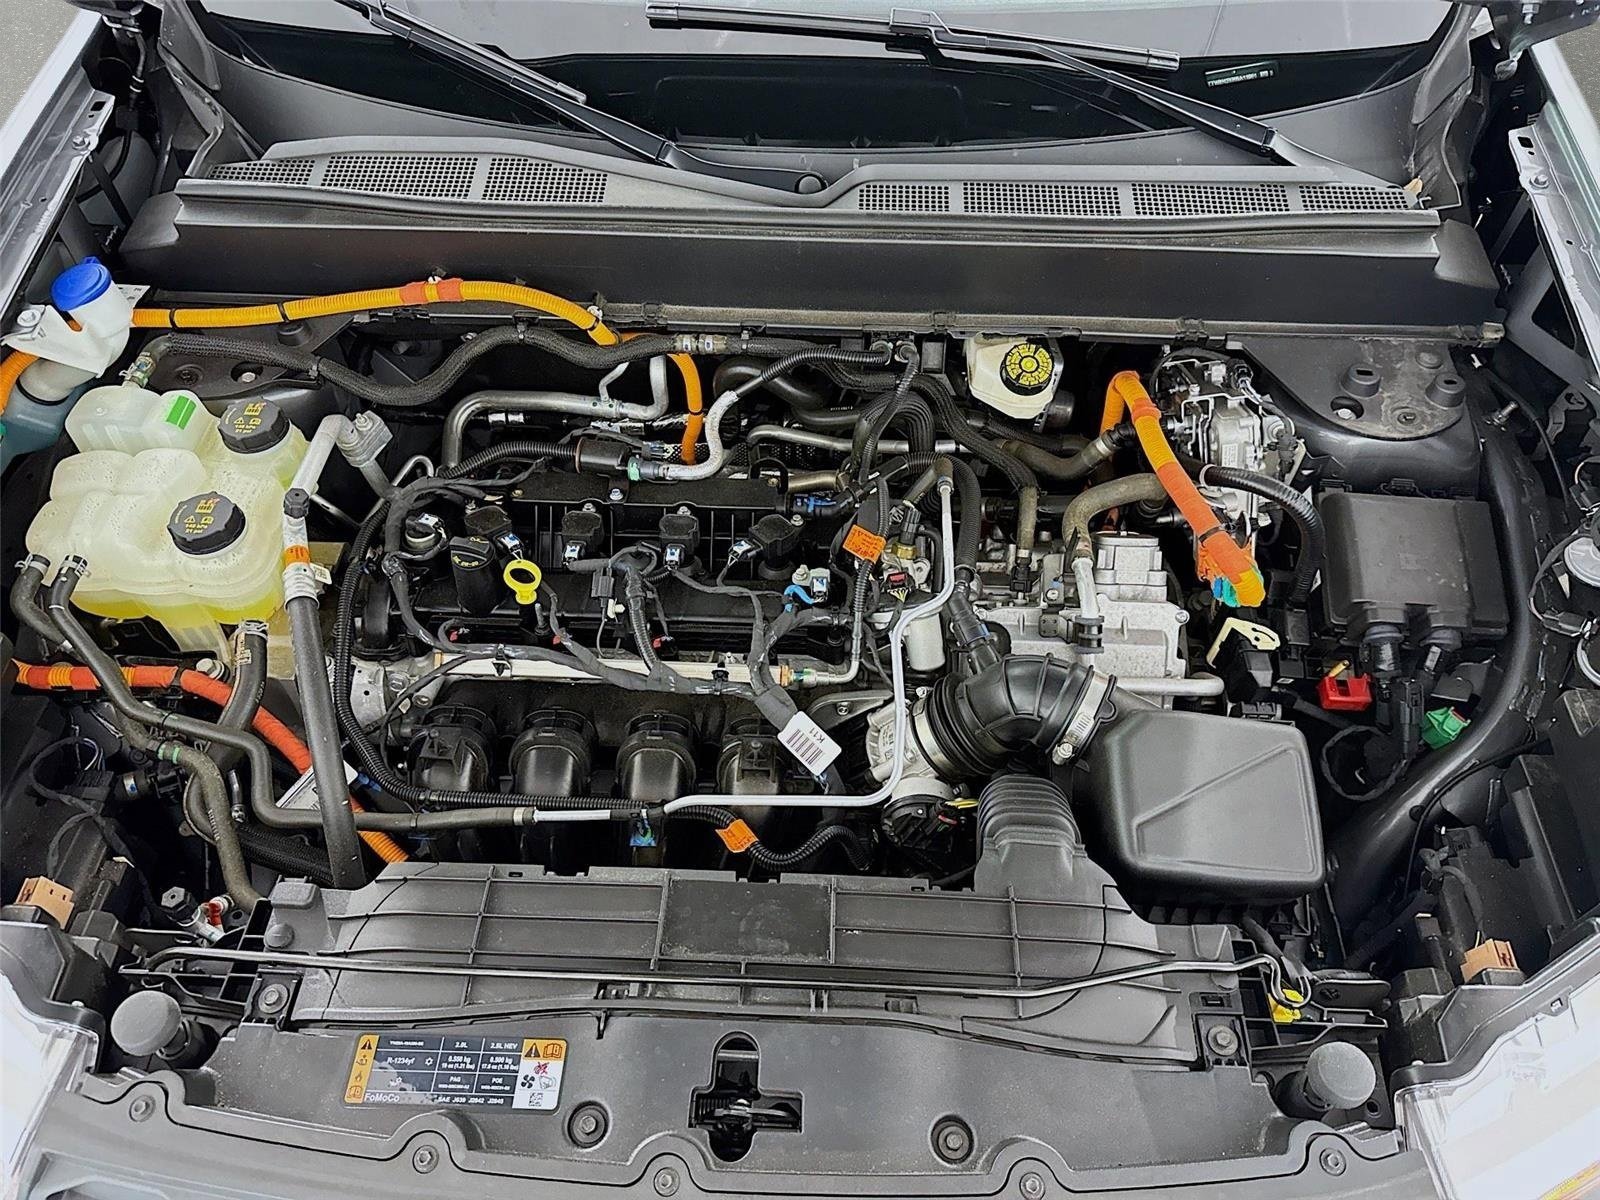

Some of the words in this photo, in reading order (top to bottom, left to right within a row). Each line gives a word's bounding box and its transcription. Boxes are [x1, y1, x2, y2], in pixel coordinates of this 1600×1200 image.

[809, 727, 825, 743] K11
[386, 1056, 416, 1066] R-1234yf
[364, 1092, 400, 1102] FoMoCo
